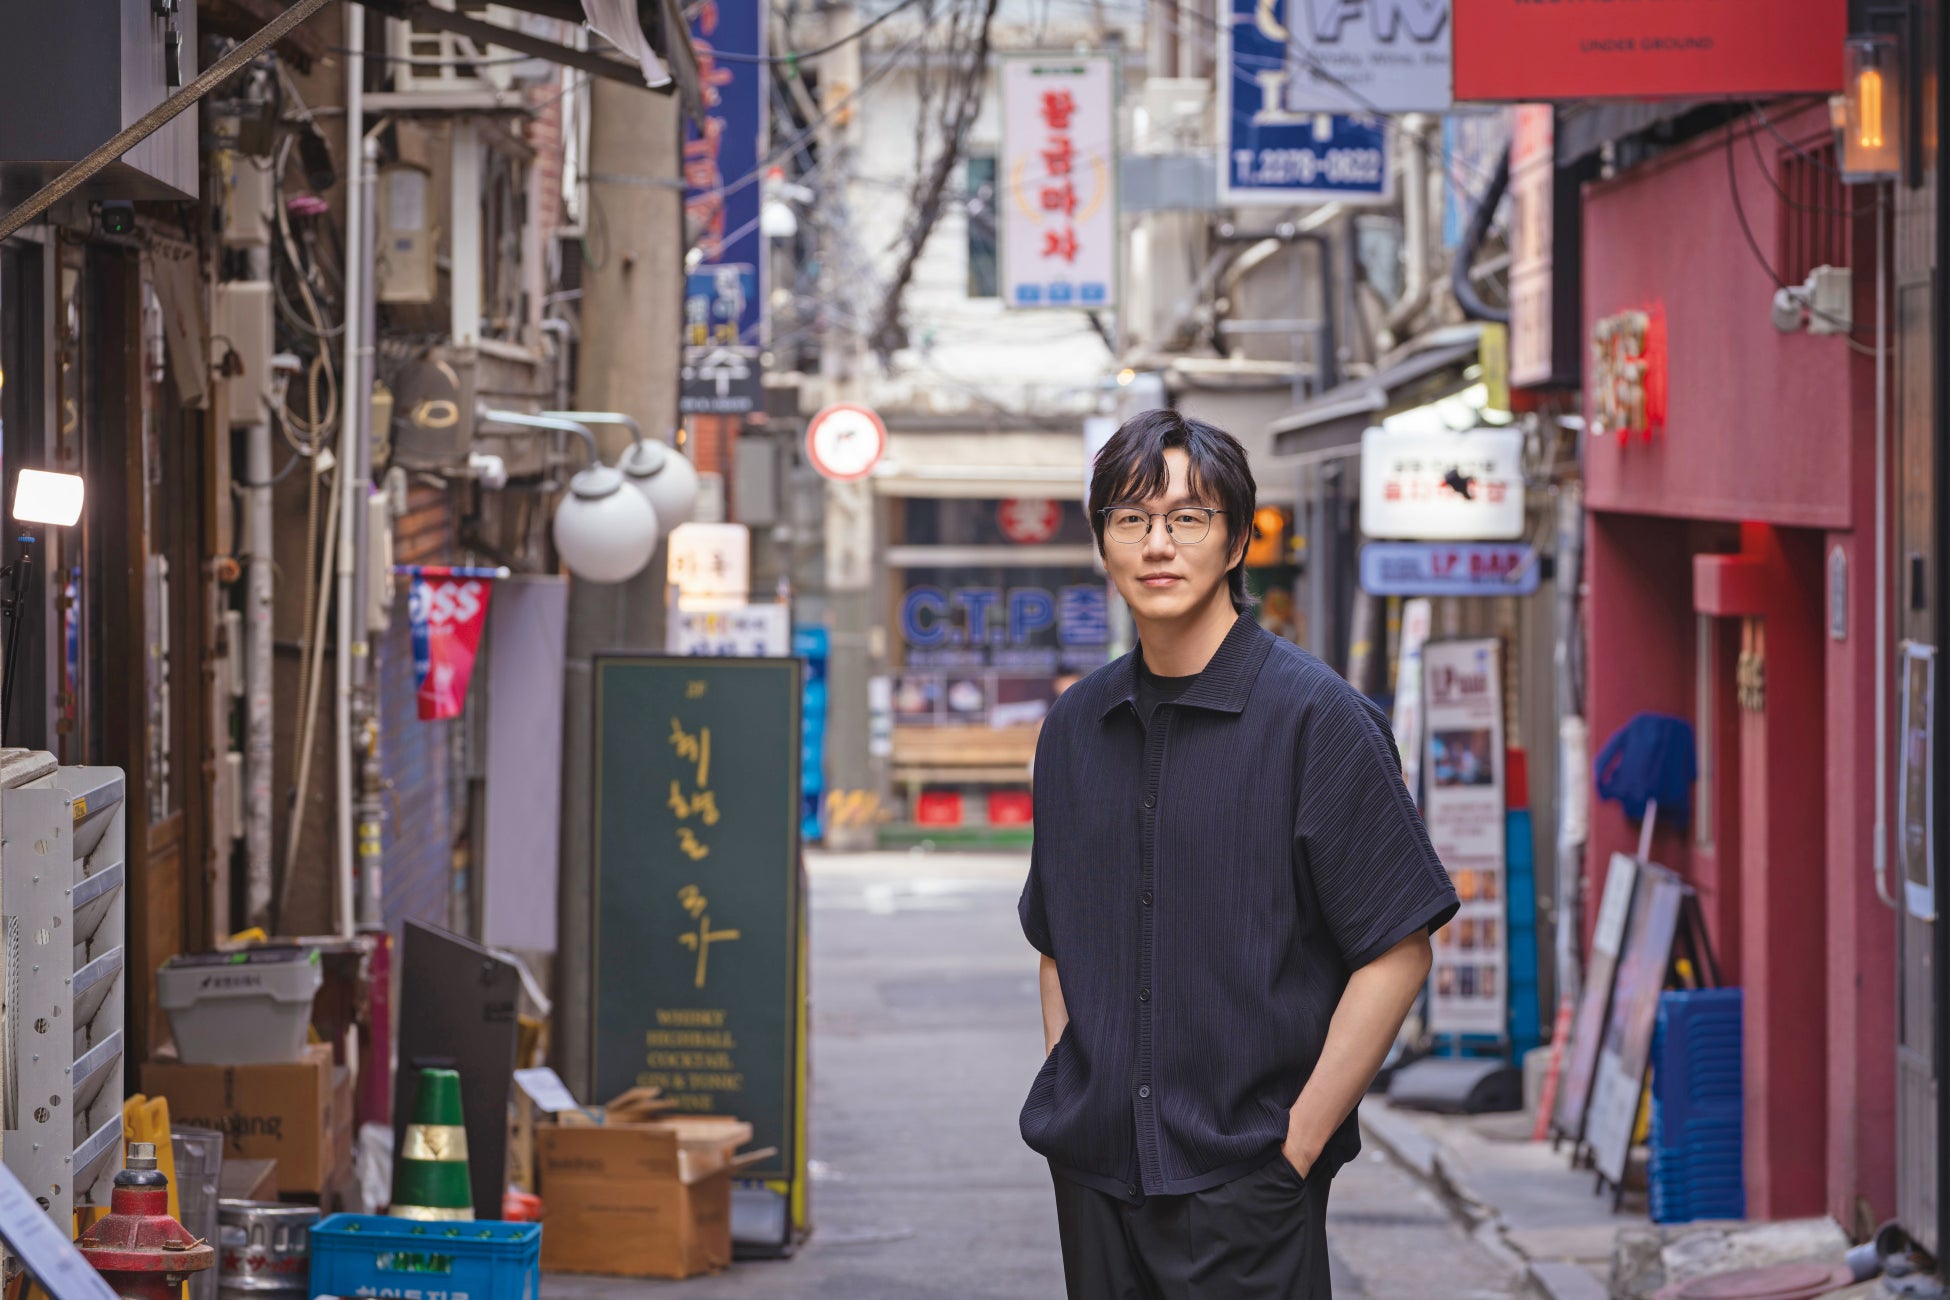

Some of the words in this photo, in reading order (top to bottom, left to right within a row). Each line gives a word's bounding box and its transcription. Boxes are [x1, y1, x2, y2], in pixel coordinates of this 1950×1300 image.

[1580, 38, 1636, 52] UNDER
[1641, 37, 1714, 50] GROUND
[1431, 553, 1458, 577] LP
[656, 1009, 727, 1026] WHISKY
[646, 1030, 736, 1048] HIGHBALL
